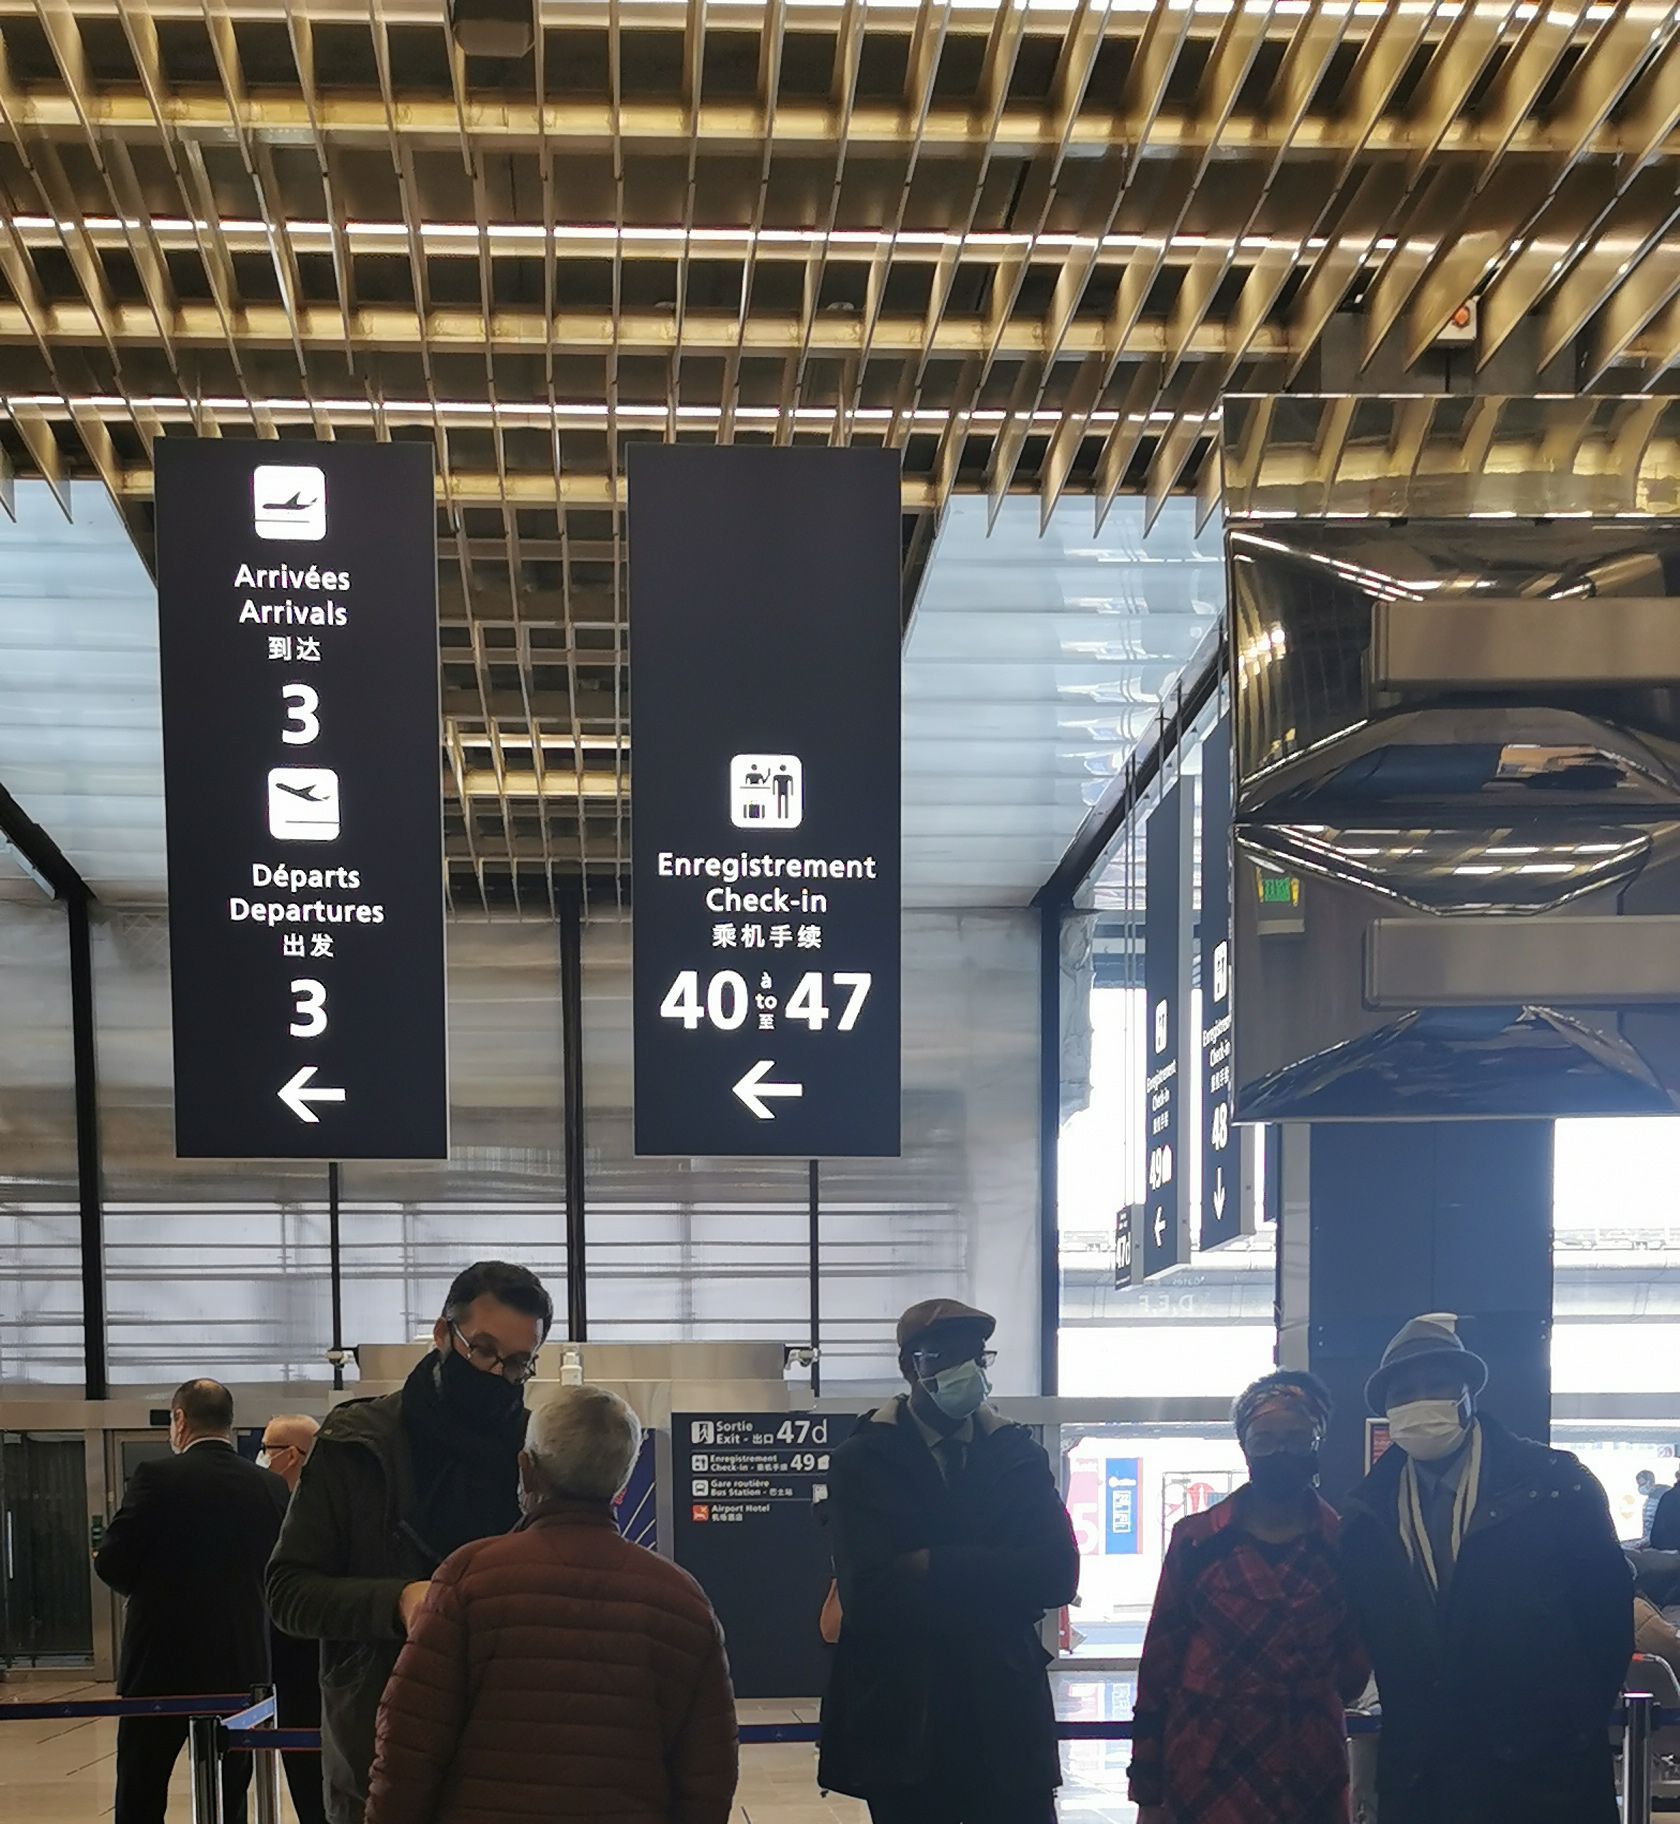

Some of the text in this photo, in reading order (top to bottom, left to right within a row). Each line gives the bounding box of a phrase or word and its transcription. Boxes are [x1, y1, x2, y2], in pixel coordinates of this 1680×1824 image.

[234, 563, 351, 591] Arrivées
[238, 599, 348, 626] Arrivals
[268, 636, 322, 662] 到达
[281, 683, 320, 745] 3
[252, 863, 361, 893] Départs
[658, 852, 877, 883] Enregistrement
[229, 897, 385, 927] Departures
[705, 887, 827, 913] Check-in
[283, 933, 334, 958] 出发
[712, 922, 822, 949] 乘机手续
[760, 971, 772, 989] à
[289, 978, 328, 1038] 3
[660, 970, 872, 1031] 40 47
[754, 993, 778, 1009] to
[758, 1013, 775, 1030] 至
[1212, 1102, 1227, 1150] 48
[716, 1420, 753, 1432] Sortie
[777, 1419, 828, 1444] 47d
[716, 1433, 740, 1445] Exit
[752, 1433, 774, 1445] 出口
[710, 1462, 749, 1472] Check-in
[790, 1453, 816, 1471] 49
[710, 1479, 732, 1489] Gare
[710, 1488, 727, 1497] Bus
[728, 1487, 761, 1497] Station
[711, 1503, 770, 1514] Airport Hotel
